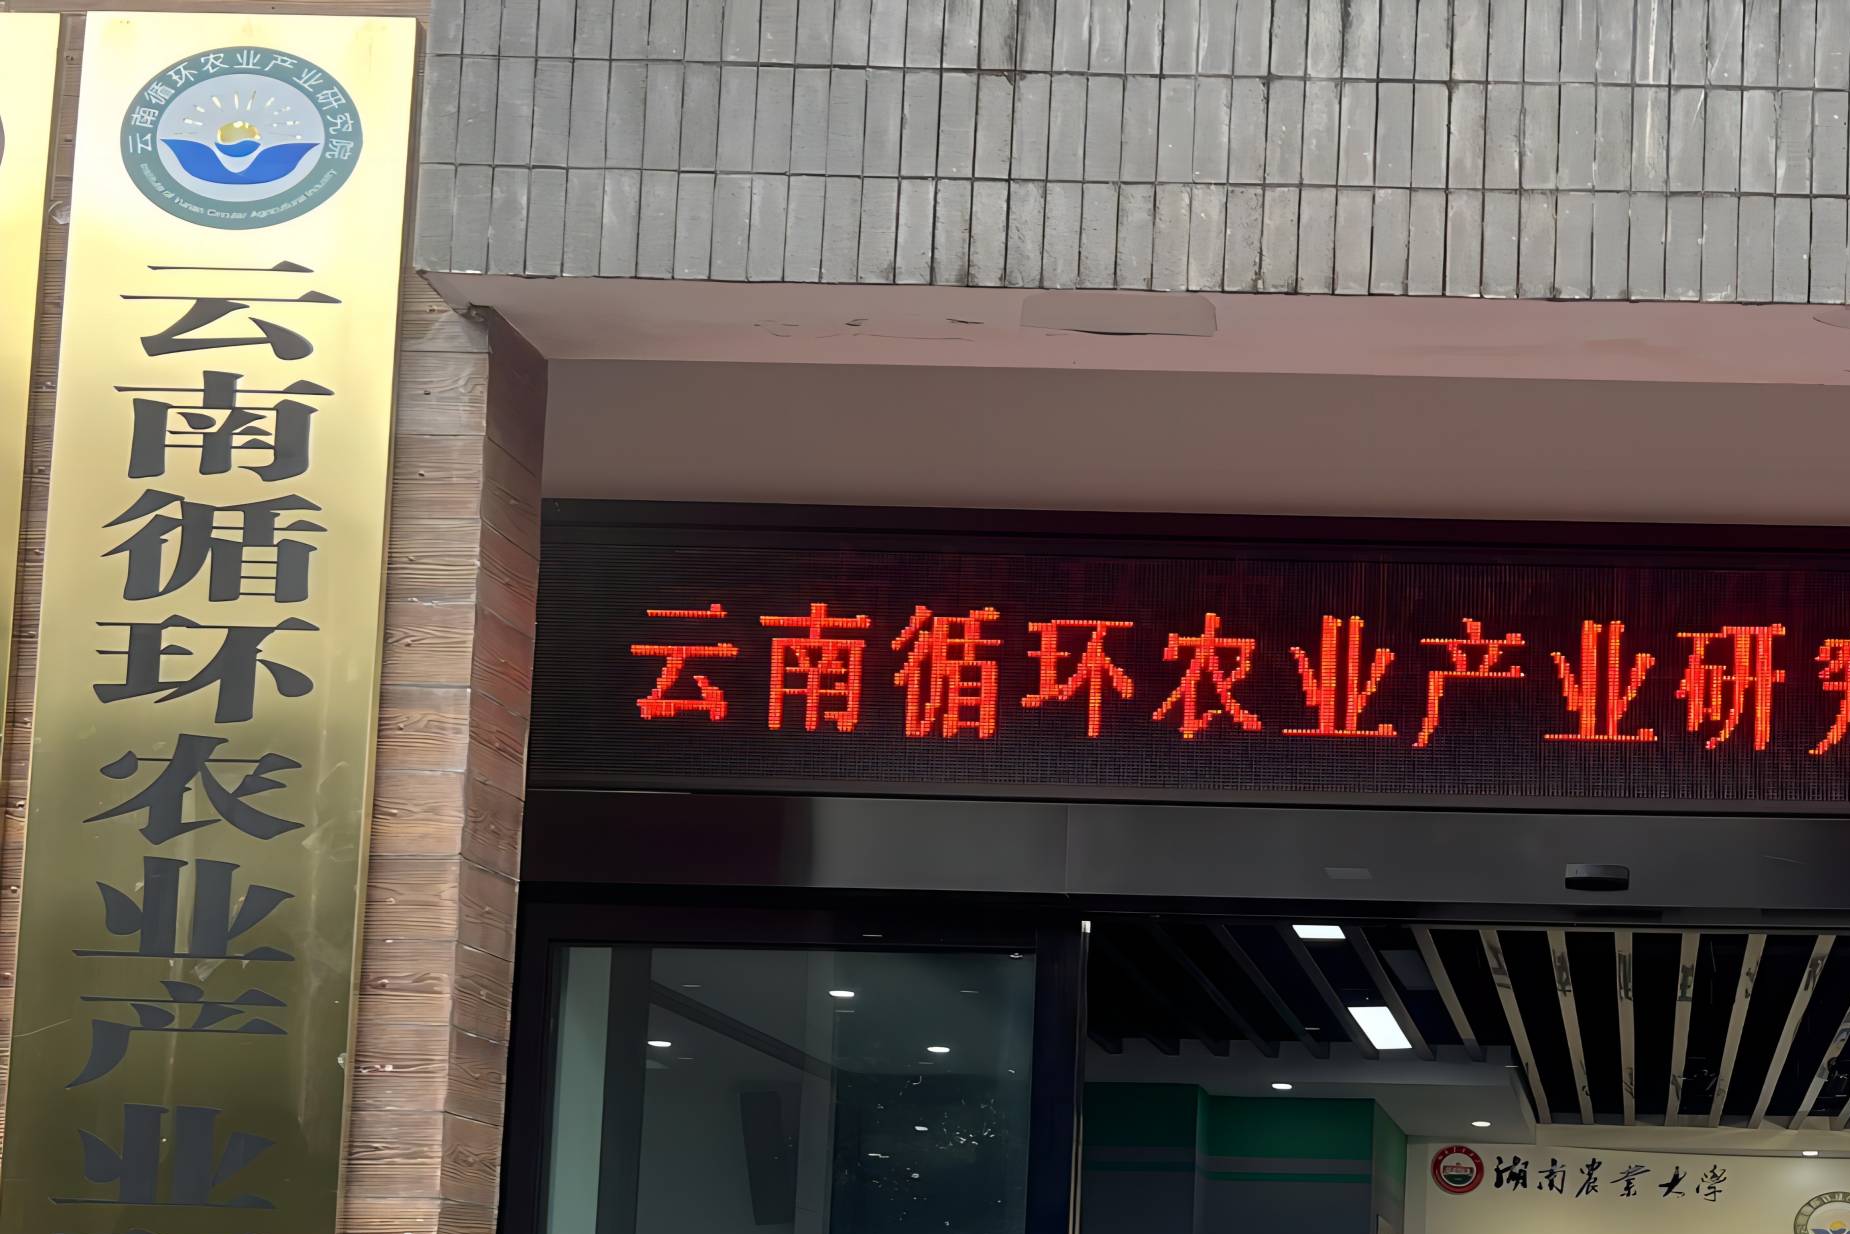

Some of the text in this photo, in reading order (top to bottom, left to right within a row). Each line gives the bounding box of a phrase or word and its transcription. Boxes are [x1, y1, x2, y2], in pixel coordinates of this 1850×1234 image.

[129, 50, 352, 160] 云南循环农业产业研究院
